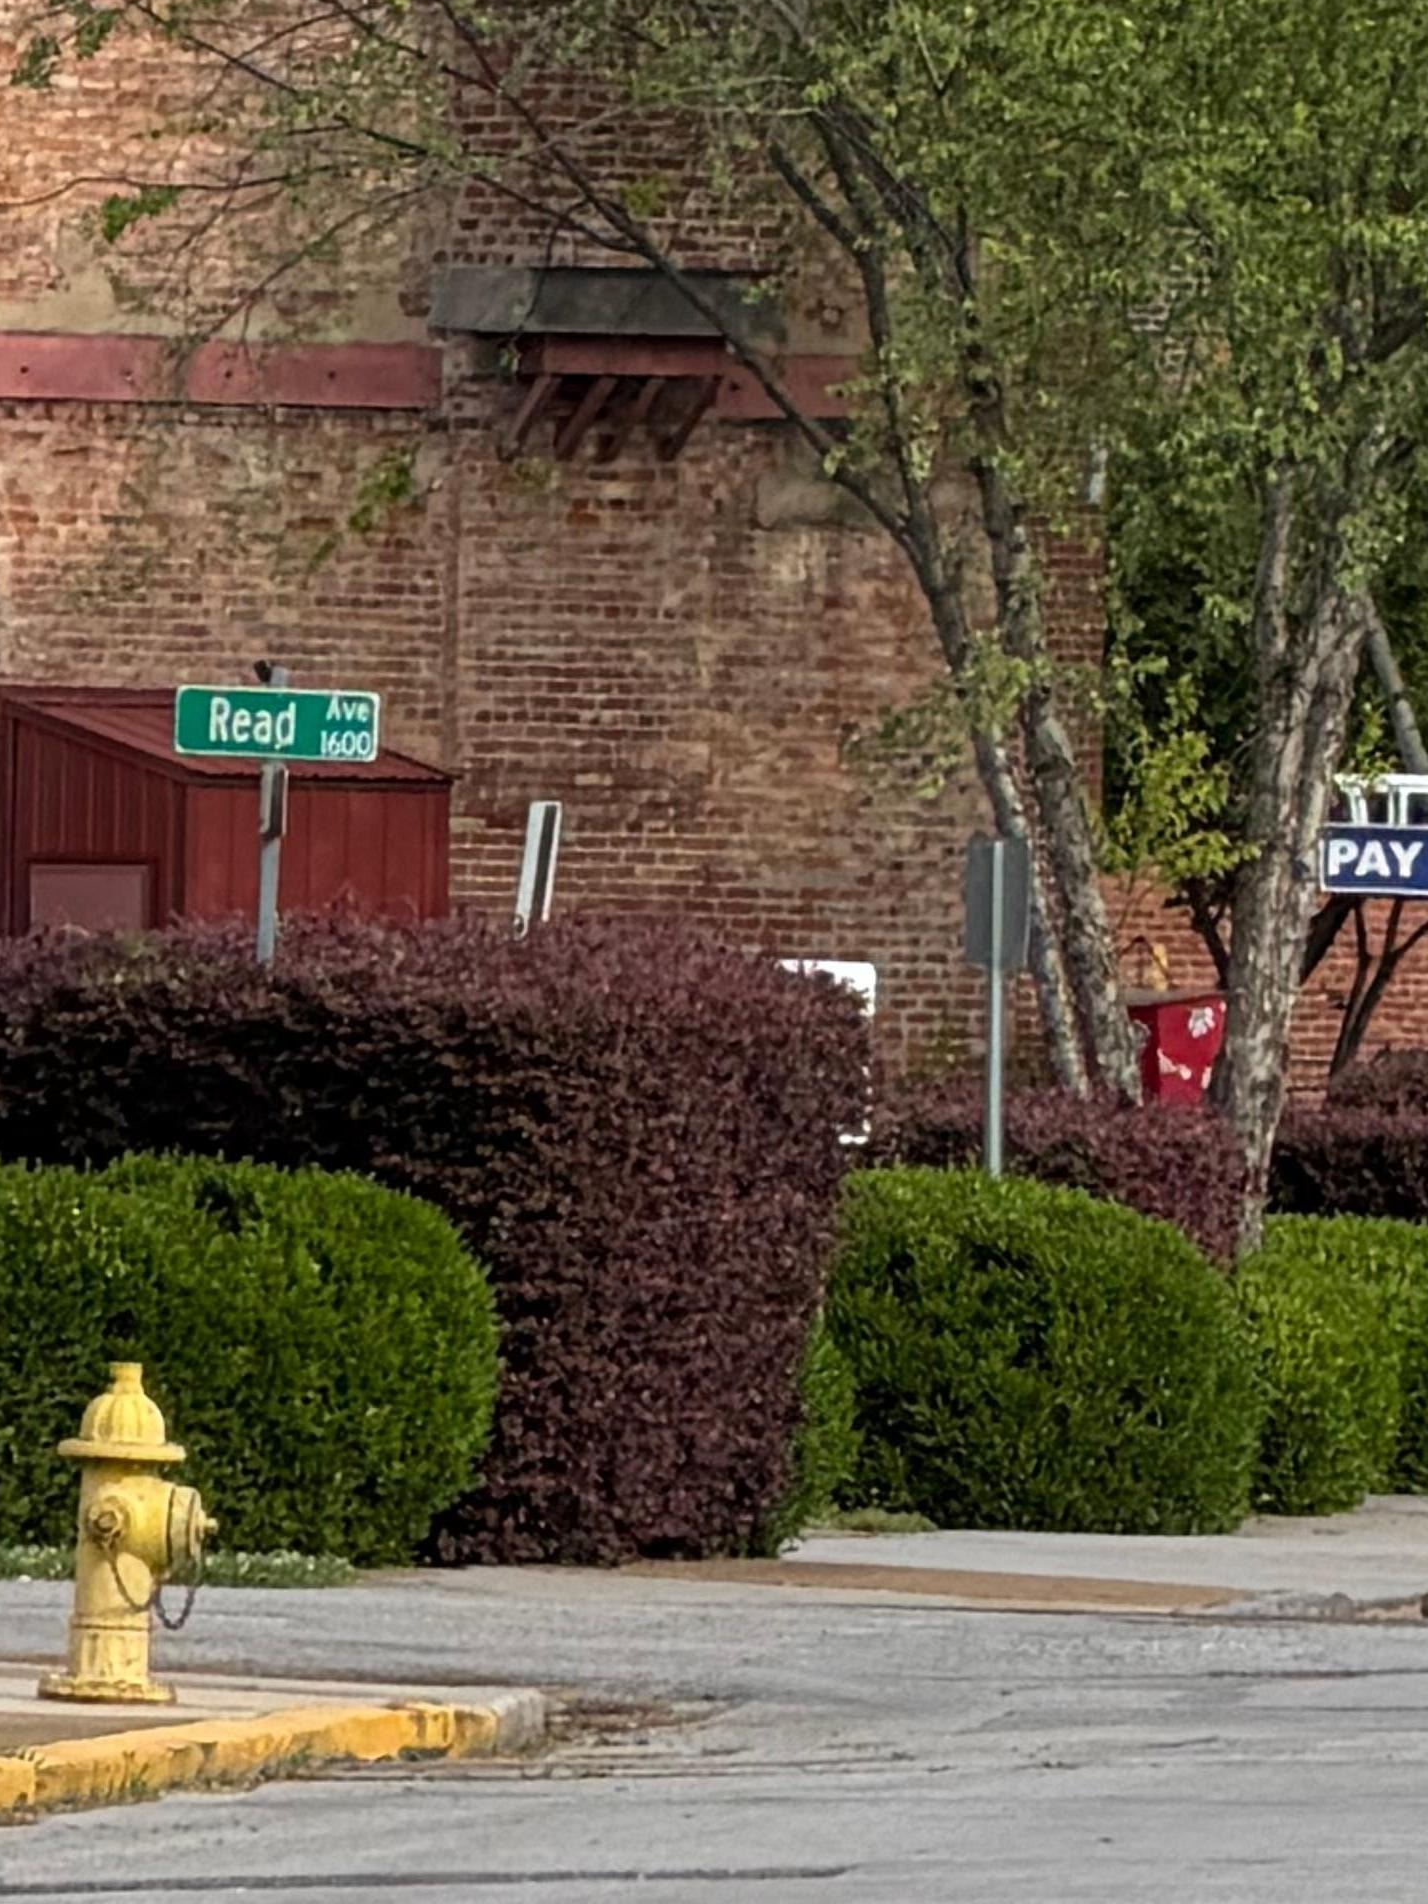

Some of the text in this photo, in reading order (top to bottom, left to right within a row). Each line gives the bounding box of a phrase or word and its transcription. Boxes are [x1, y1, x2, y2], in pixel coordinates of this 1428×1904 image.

[209, 695, 370, 746] Read Ave
[320, 729, 371, 756] 1600
[1327, 840, 1423, 878] PAY
